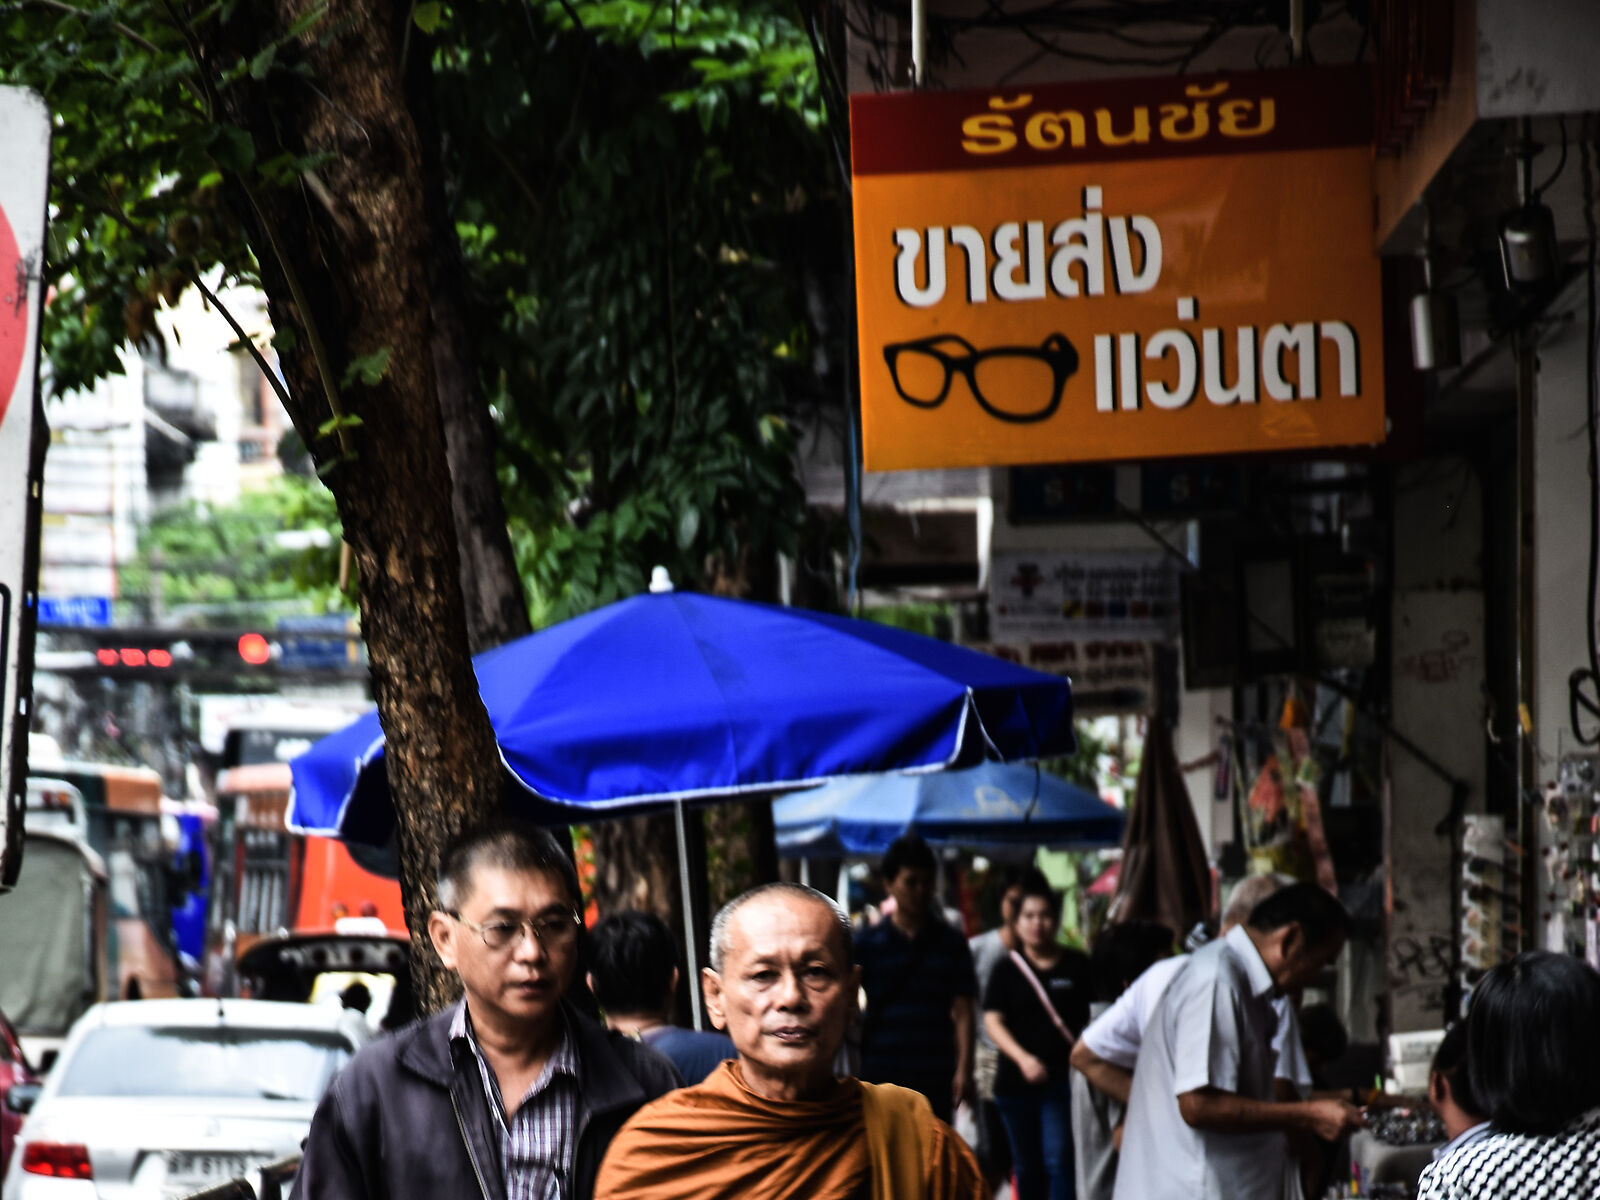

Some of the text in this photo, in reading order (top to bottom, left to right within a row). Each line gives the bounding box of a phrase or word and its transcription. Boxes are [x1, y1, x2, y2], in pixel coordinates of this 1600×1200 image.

[961, 82, 1276, 154] รัตนชัย
[893, 186, 1163, 306] ขายส่ง
[1093, 298, 1359, 411] แว่นตา
